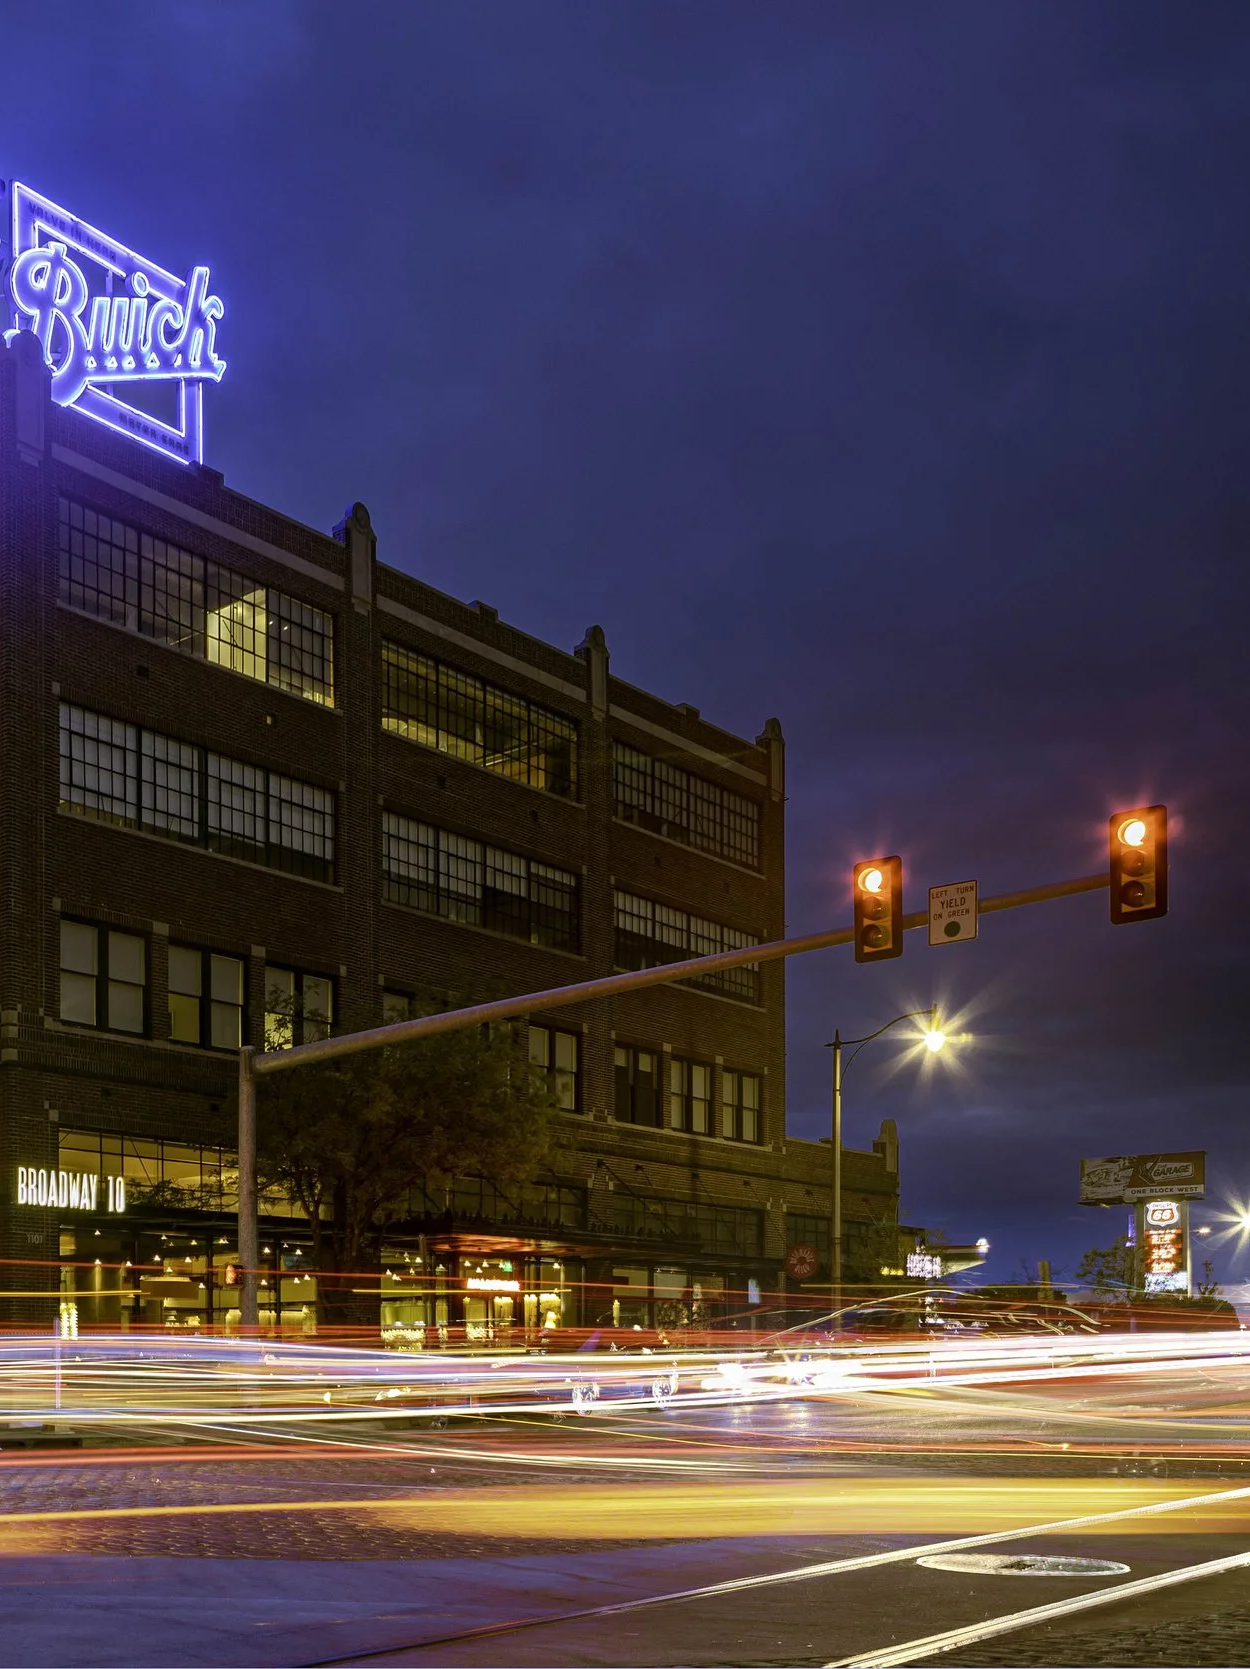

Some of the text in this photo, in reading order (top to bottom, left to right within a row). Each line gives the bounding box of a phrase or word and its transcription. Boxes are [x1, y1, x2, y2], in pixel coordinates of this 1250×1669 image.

[70, 226, 82, 243] IN
[9, 240, 227, 407] Buick
[931, 885, 974, 900] LEFT TURN
[940, 896, 966, 909] YIELD
[933, 908, 970, 921] ON GREEN
[1153, 1164, 1191, 1177] GARAGE
[17, 1166, 126, 1213] BROADWAY 10
[1152, 1209, 1172, 1221] 66
